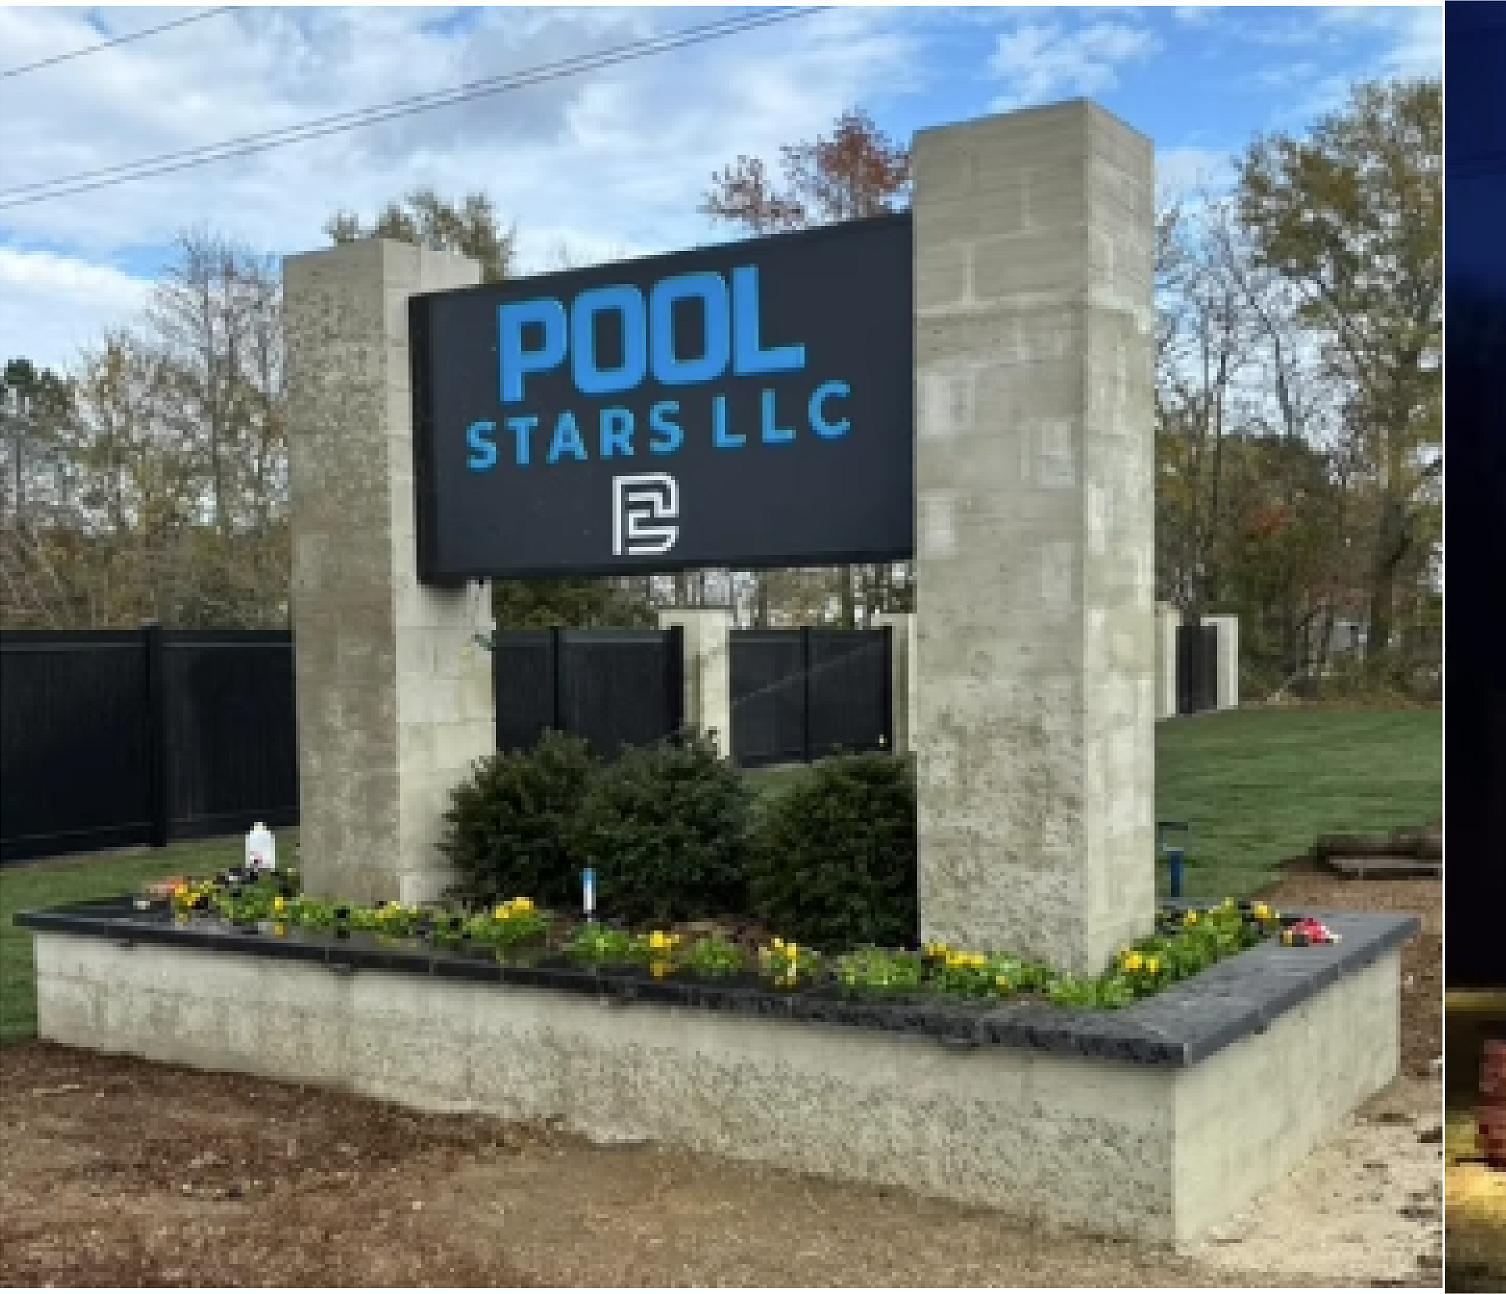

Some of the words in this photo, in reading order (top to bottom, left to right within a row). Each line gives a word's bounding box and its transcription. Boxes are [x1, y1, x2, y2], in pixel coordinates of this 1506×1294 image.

[498, 264, 805, 402] POOL
[466, 400, 685, 472] STARS
[712, 380, 851, 448] LLC
